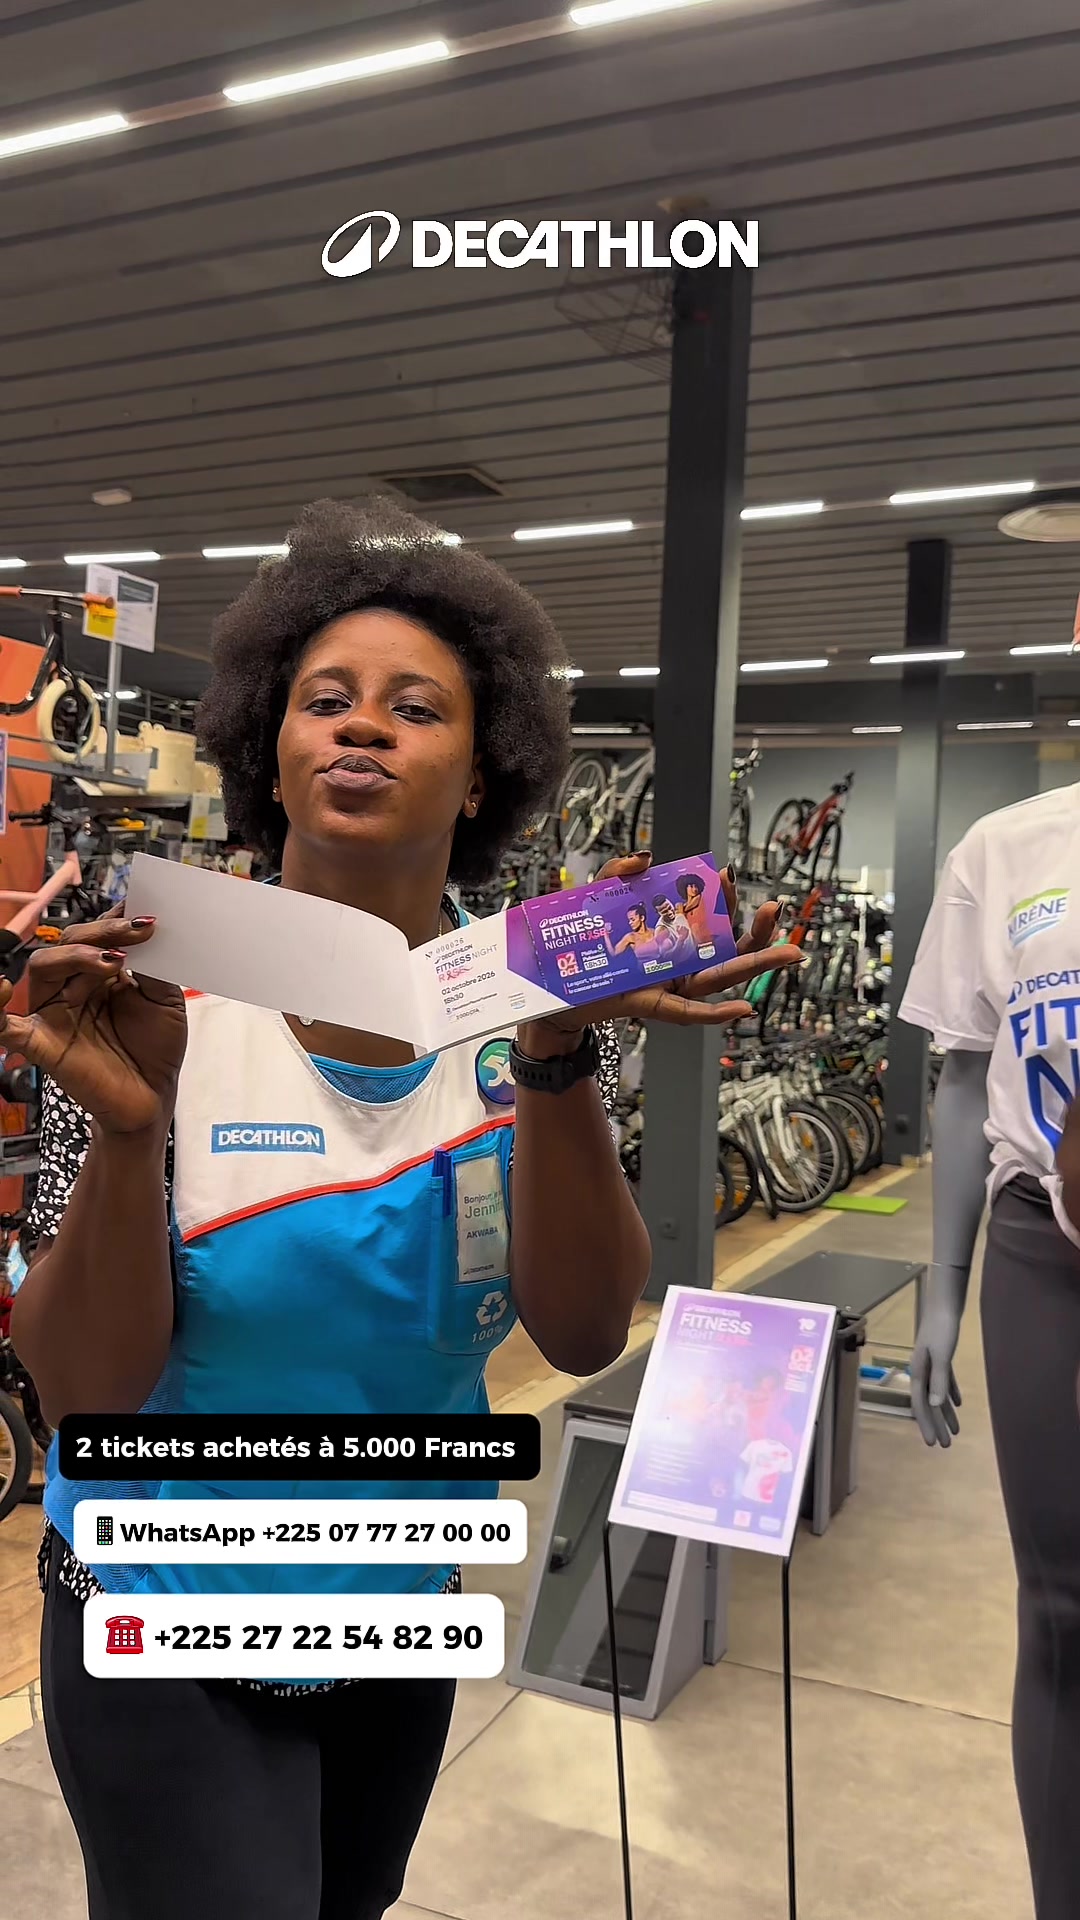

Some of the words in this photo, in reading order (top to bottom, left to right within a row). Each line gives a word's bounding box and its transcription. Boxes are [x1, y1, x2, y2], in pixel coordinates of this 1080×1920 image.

[549, 909, 589, 925] DECATHLON
[541, 915, 604, 941] FITNESS
[545, 935, 577, 950] NIGHT
[435, 954, 472, 974] FITNESS
[471, 944, 498, 959] NIGHT
[441, 944, 473, 960] DECATHLON
[558, 953, 577, 970] 02
[586, 959, 608, 970] 18h30
[441, 987, 451, 996] 02
[451, 978, 477, 992] octobre
[477, 971, 496, 983] 2026
[218, 1129, 320, 1147] DECATHLON
[466, 1226, 498, 1241] AKWABA
[680, 1313, 752, 1335] FITNESS
